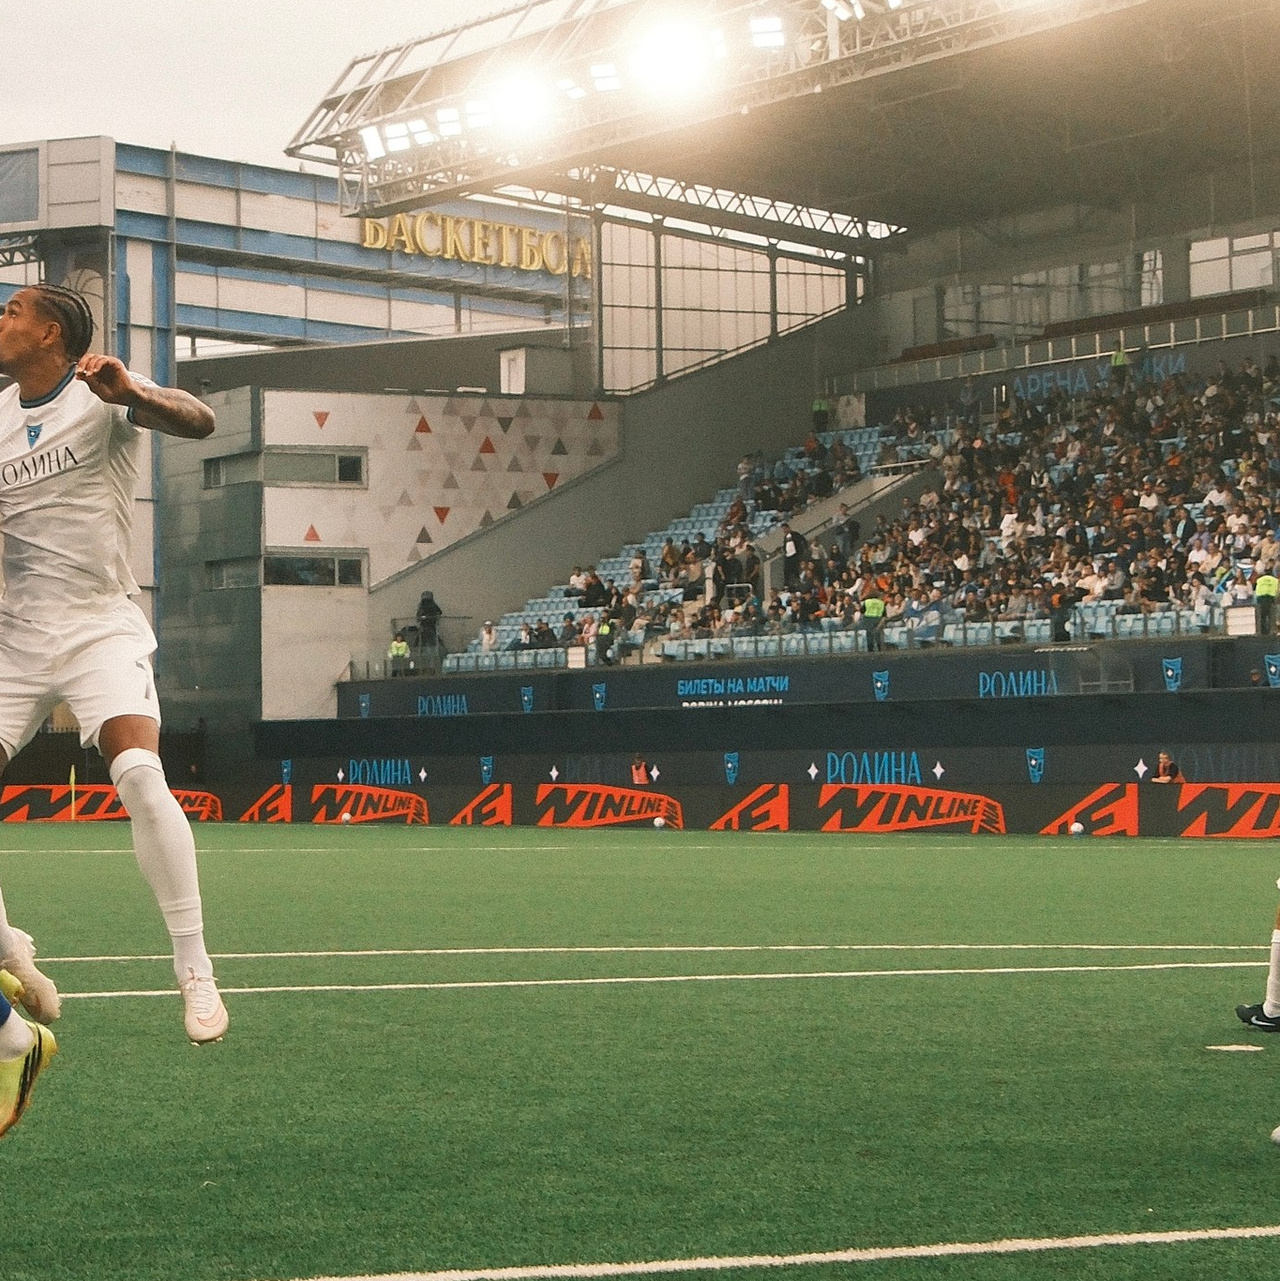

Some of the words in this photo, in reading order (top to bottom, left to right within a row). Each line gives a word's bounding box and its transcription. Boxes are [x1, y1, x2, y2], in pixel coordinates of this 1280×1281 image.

[1096, 354, 1186, 384] ХКИ
[677, 679, 724, 695] БИЛЕТЫ
[727, 678, 744, 693] НА
[747, 676, 789, 693] МАТЧИ
[979, 670, 1059, 698] РОДИНА
[349, 759, 412, 785] РОДИНА
[826, 751, 922, 784] РОДИНА
